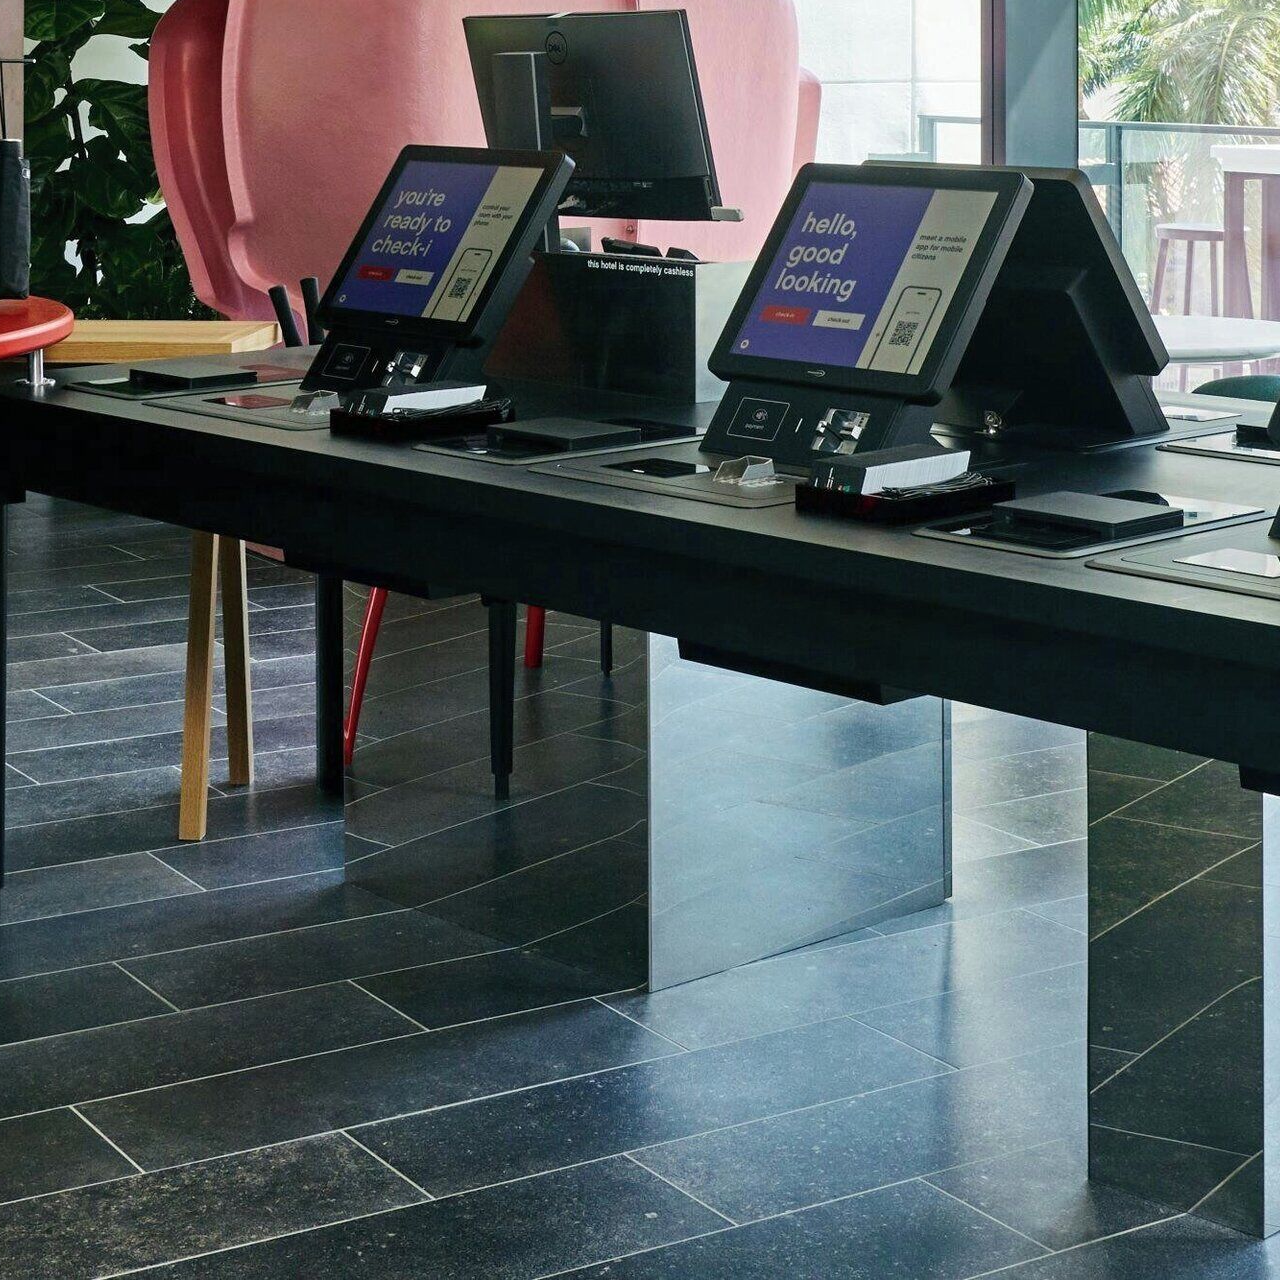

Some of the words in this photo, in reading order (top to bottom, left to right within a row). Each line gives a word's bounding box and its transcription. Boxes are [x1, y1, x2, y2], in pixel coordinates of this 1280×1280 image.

[393, 188, 446, 209] you're
[383, 212, 433, 236] ready
[433, 215, 451, 233] to
[801, 211, 857, 240] hello,
[940, 245, 963, 253] mobile
[944, 235, 967, 243] mobile
[786, 243, 849, 268] good
[911, 252, 937, 261] citizens
[587, 260, 600, 269] this
[600, 260, 617, 270] hotel
[618, 262, 625, 271] is
[625, 264, 663, 276] completely
[663, 267, 694, 277] cashless
[774, 267, 857, 302] looking
